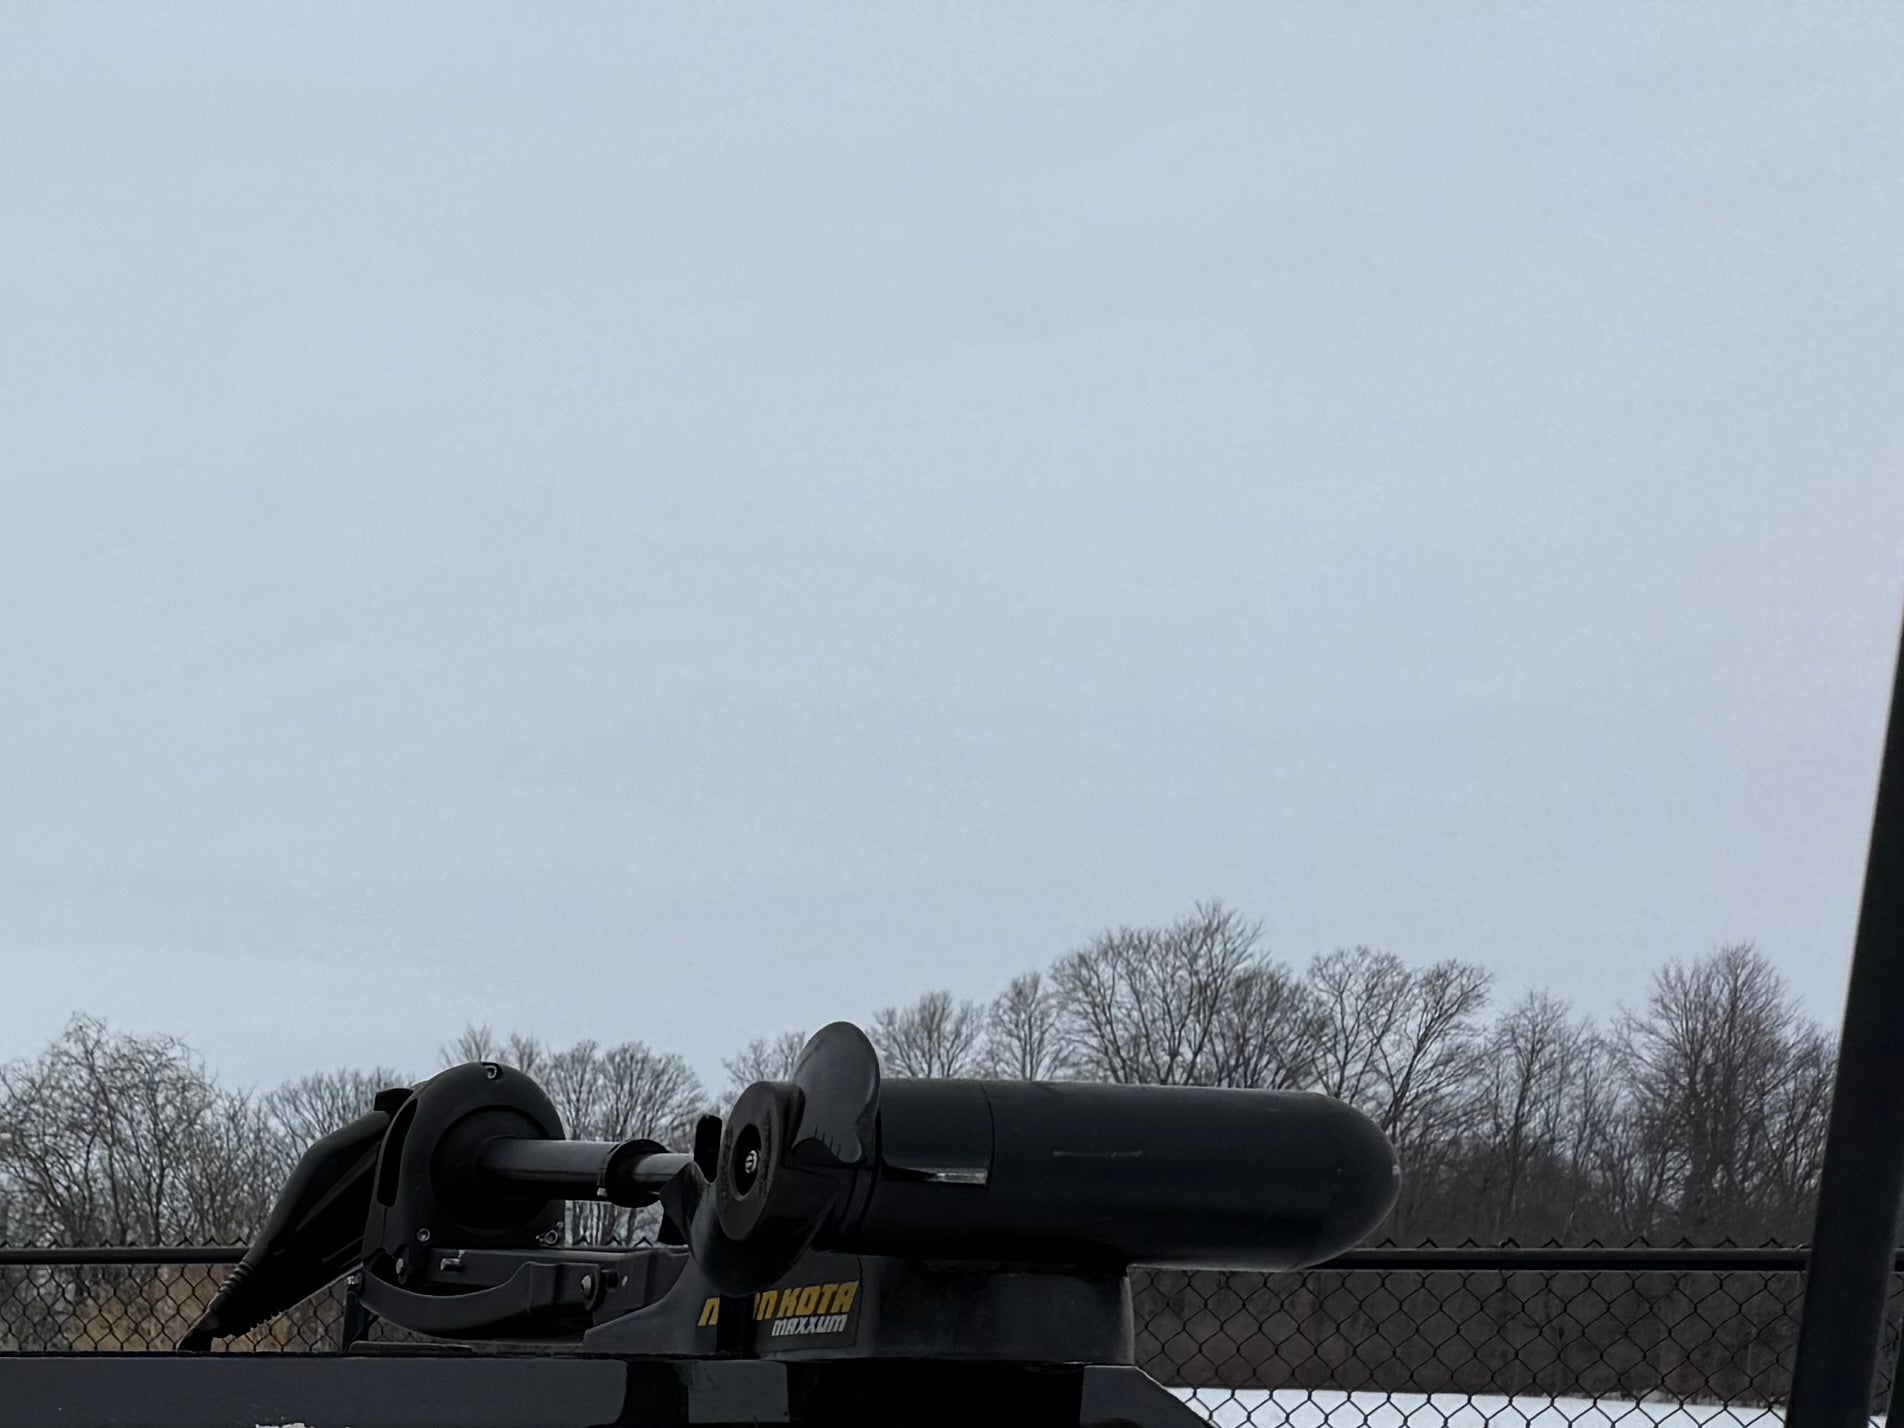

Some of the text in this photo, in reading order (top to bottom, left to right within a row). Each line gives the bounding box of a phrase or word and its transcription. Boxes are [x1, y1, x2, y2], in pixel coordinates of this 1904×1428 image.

[697, 1280, 860, 1327] MN KOTA
[771, 1314, 848, 1336] MAXXUM
